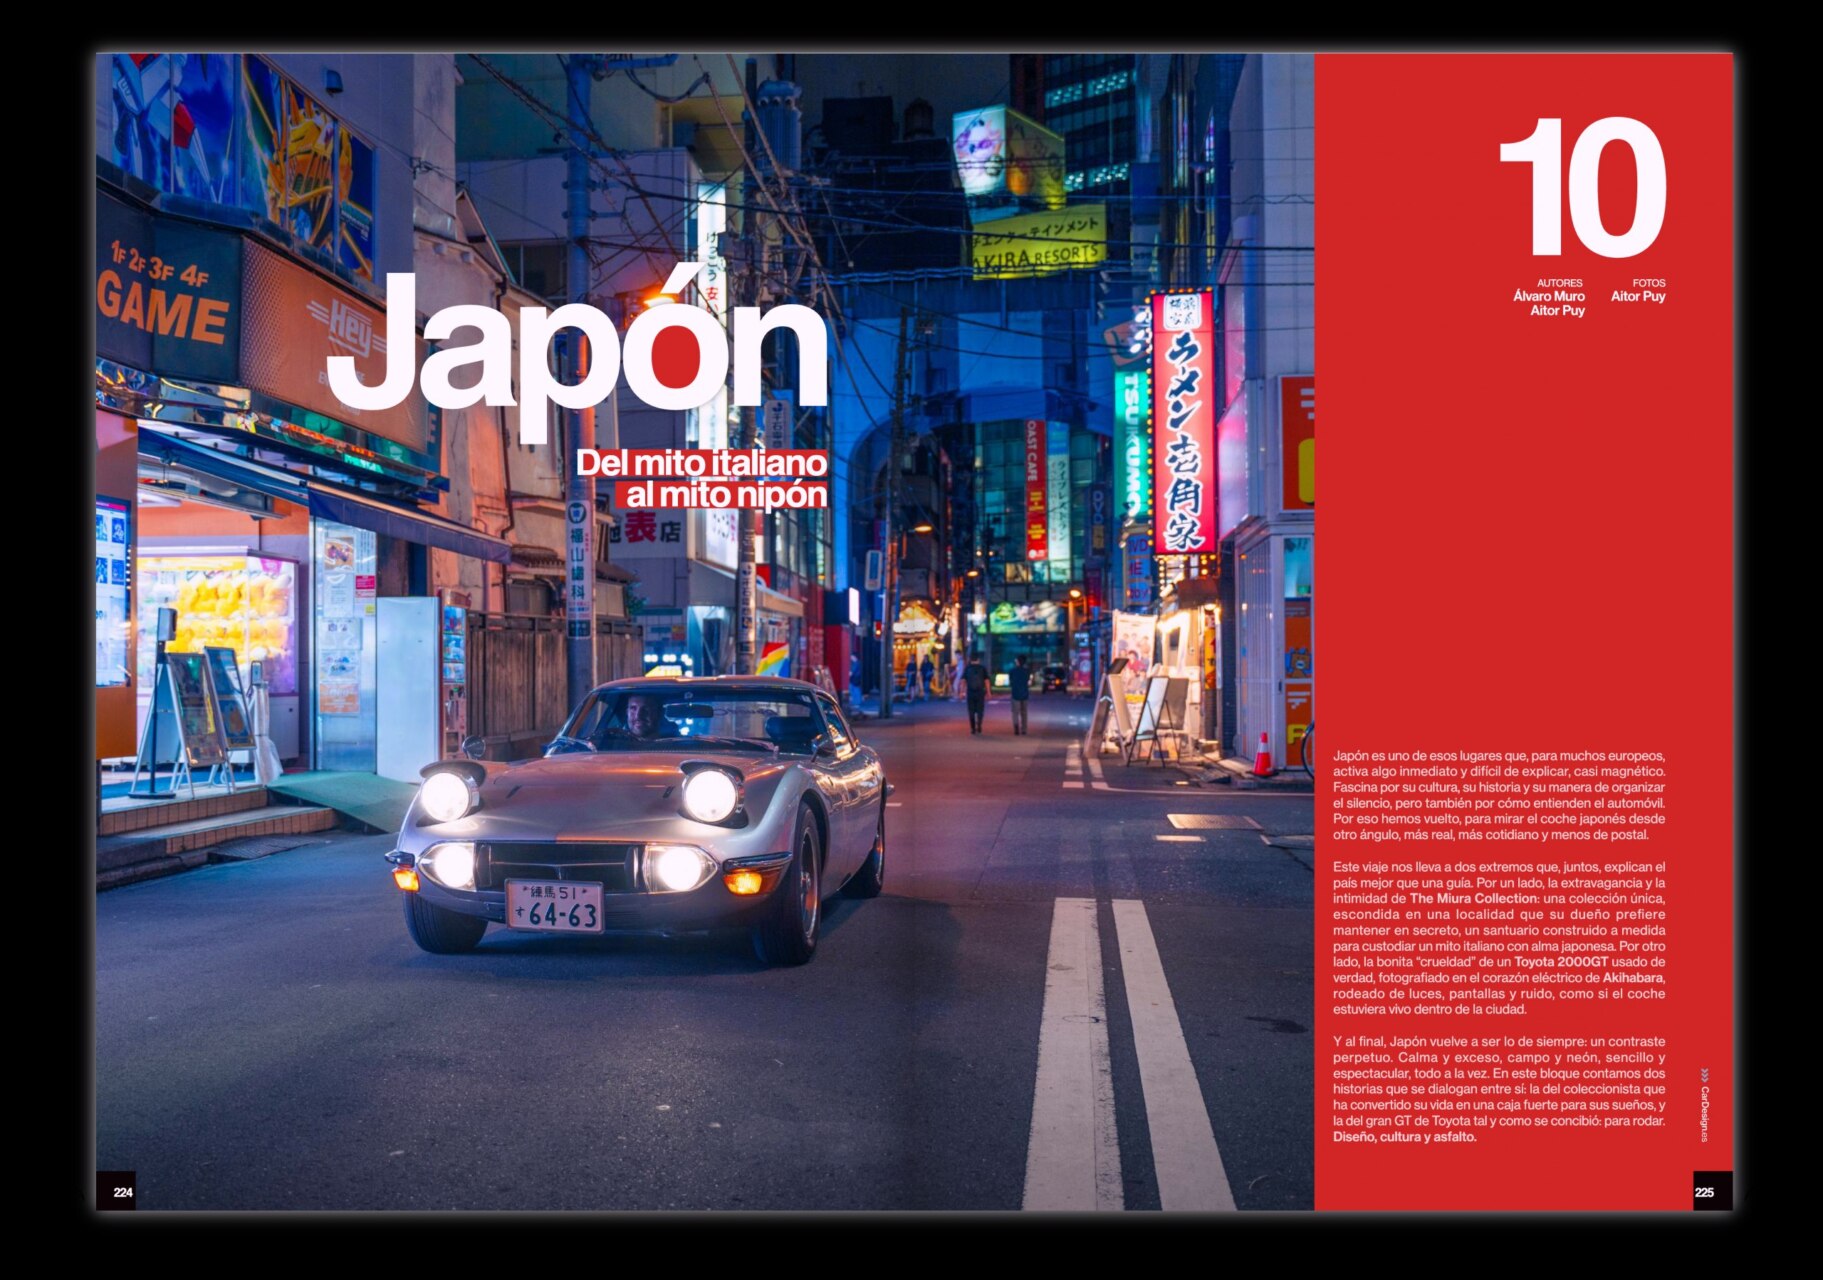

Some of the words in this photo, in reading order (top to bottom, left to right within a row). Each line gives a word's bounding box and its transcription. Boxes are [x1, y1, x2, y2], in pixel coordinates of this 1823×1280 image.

[112, 240, 126, 264] 1F
[128, 248, 146, 273] 2F
[149, 256, 175, 281] 3F
[180, 264, 209, 287] 4F
[1034, 244, 1099, 265] RESORTS
[97, 269, 230, 345] GAME
[329, 299, 373, 358] Hey
[1027, 454, 1038, 481] CAFE
[559, 886, 576, 900] 51
[529, 902, 597, 928] 64-63
